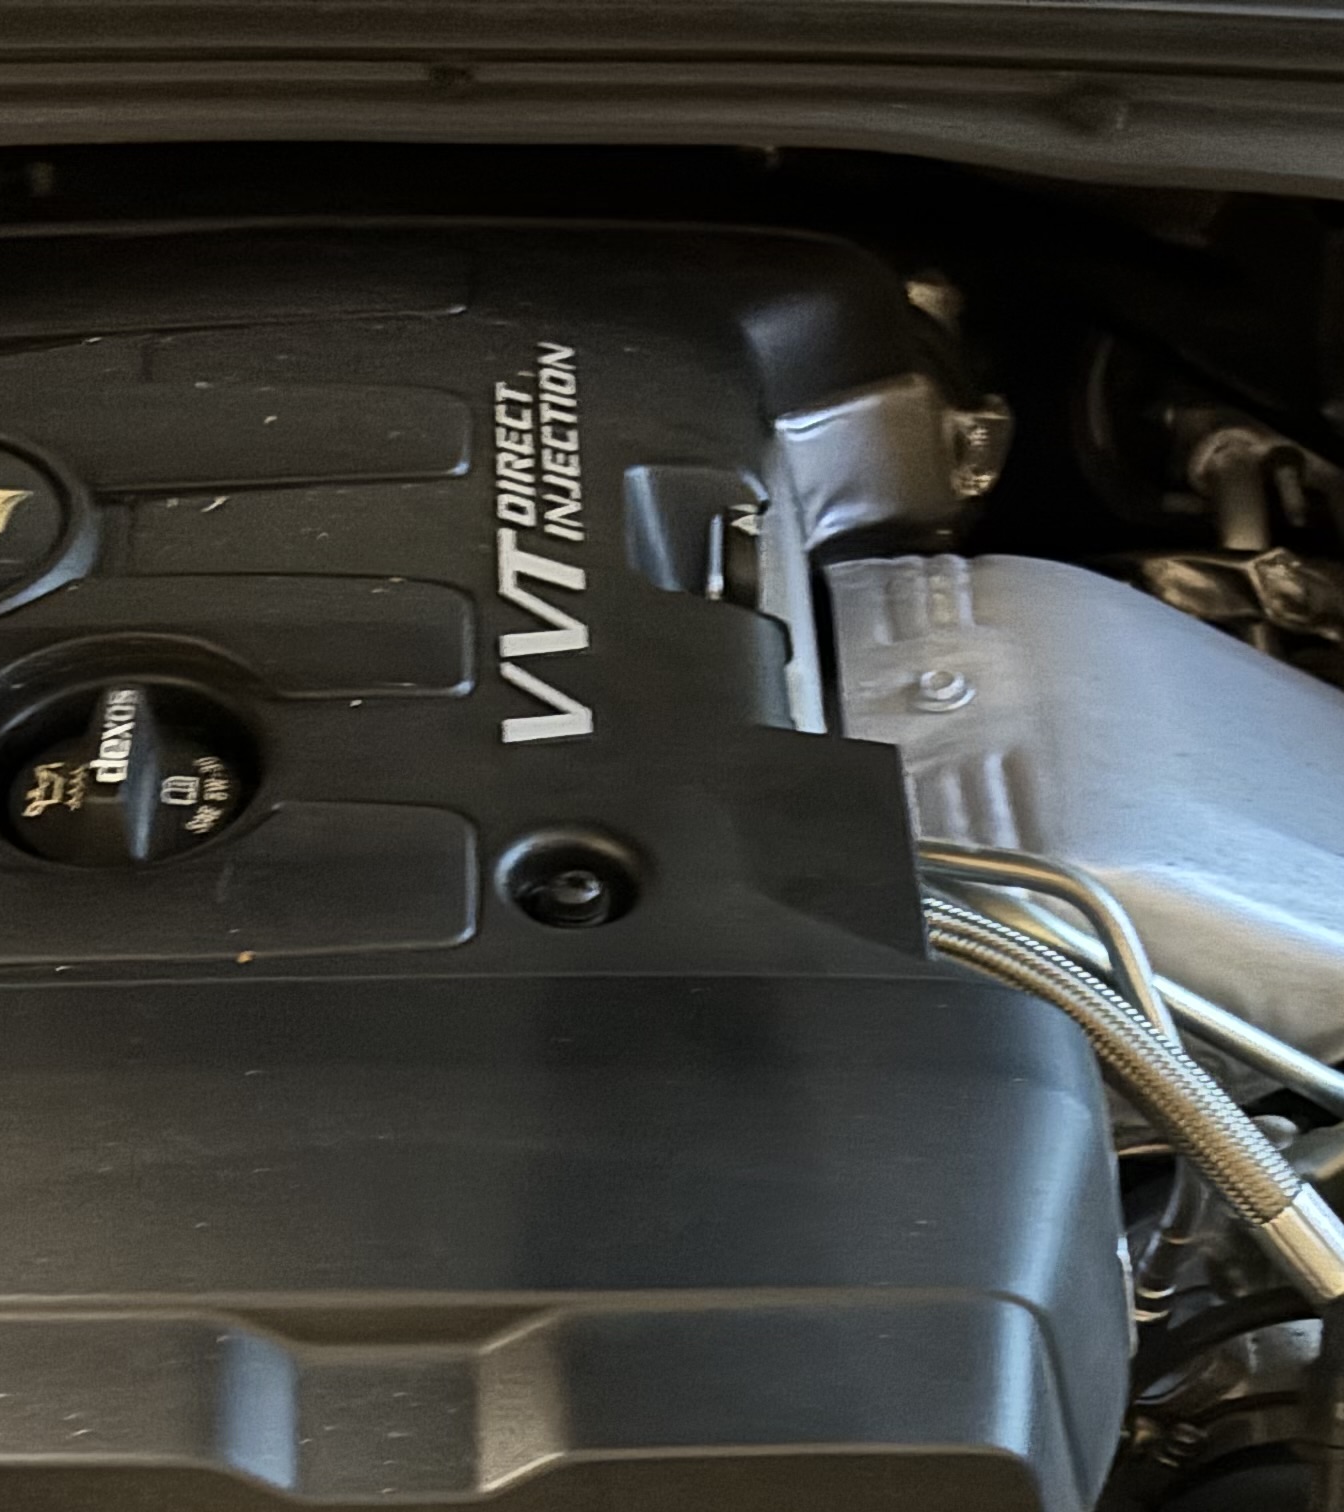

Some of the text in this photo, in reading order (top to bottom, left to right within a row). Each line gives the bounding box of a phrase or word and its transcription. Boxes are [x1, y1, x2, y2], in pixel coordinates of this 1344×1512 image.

[495, 381, 537, 527] DIRECT
[537, 342, 584, 541] INJECTION
[497, 528, 593, 743] VVT
[90, 689, 140, 783] dexos
